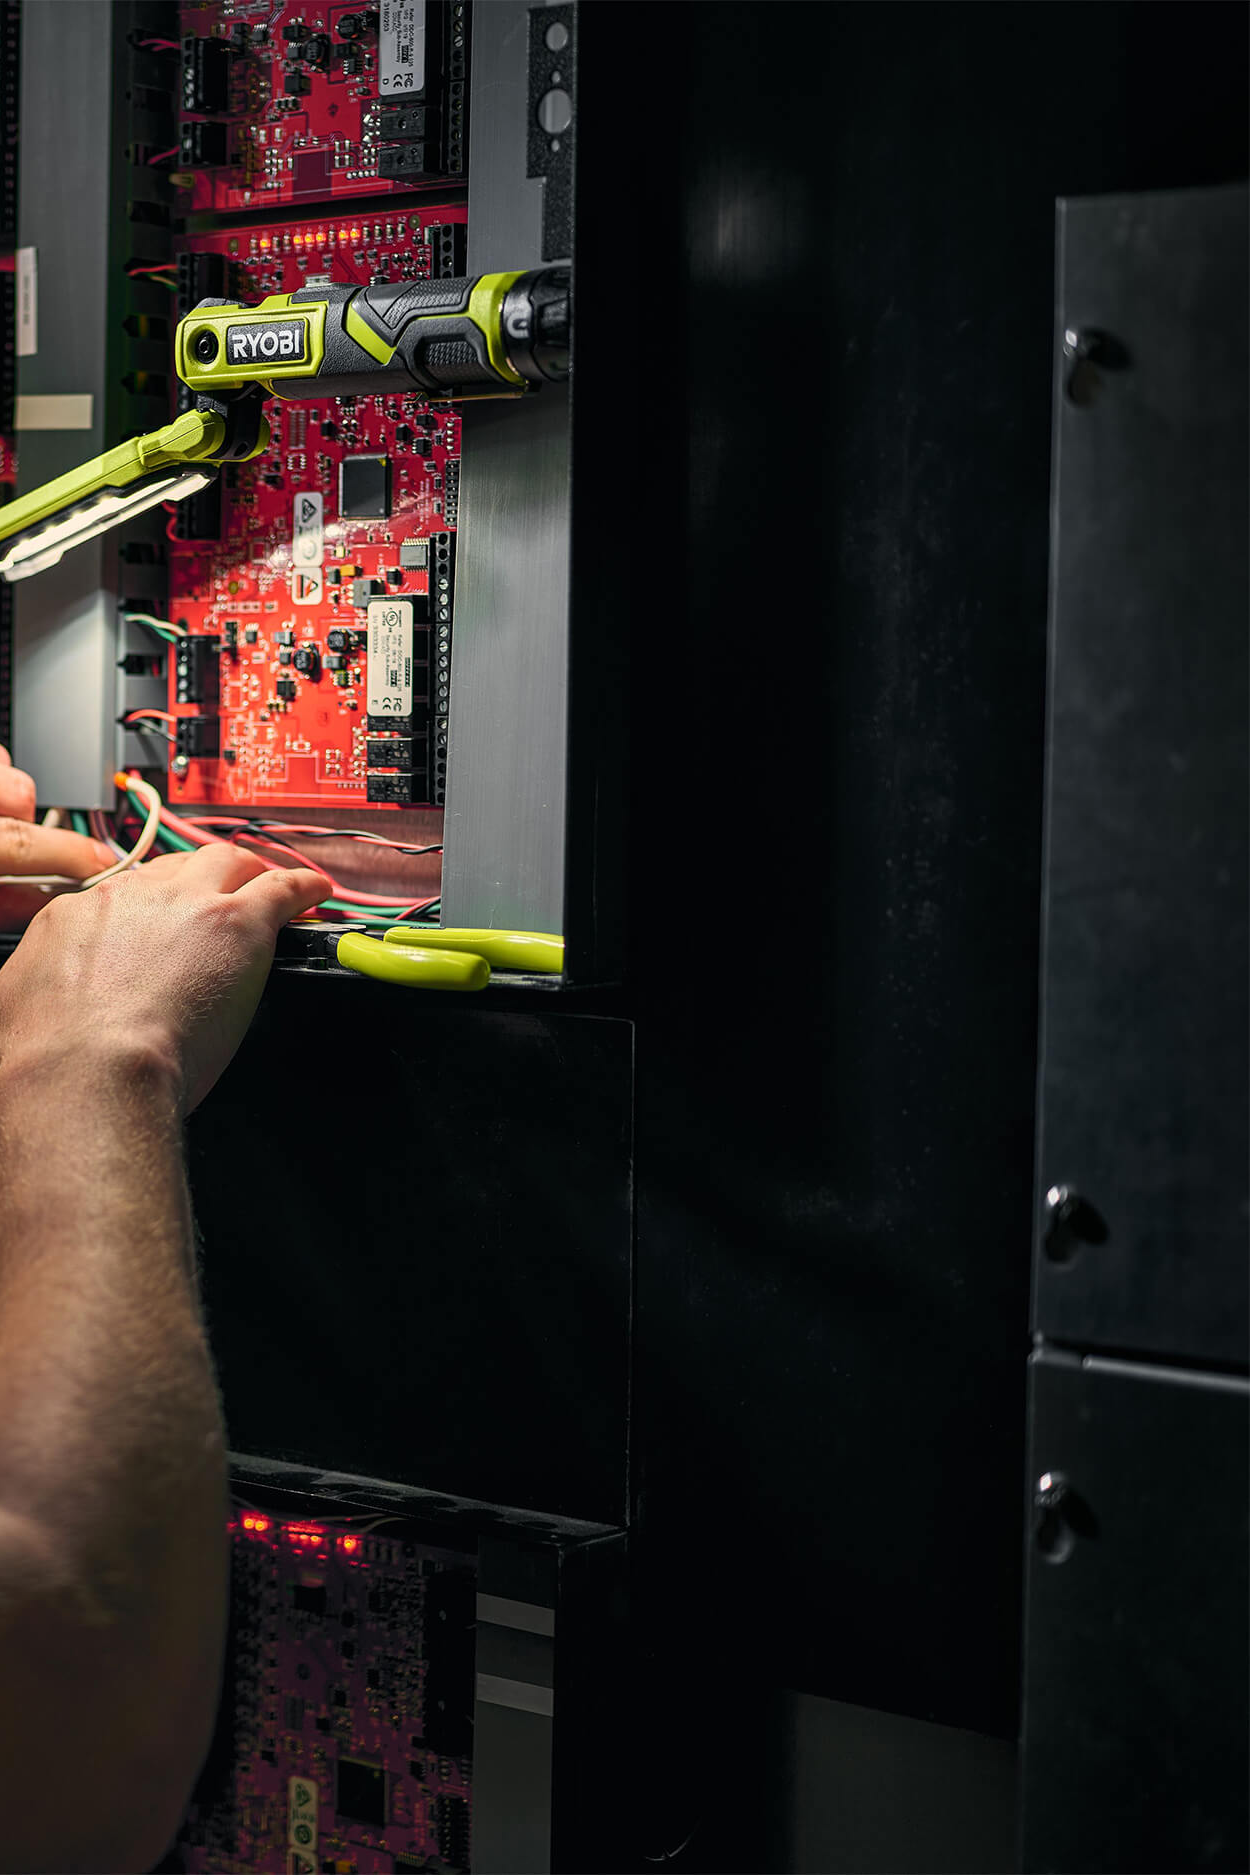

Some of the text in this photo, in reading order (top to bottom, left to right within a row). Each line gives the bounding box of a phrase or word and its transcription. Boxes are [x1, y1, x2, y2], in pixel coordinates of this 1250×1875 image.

[393, 74, 403, 88] CE
[232, 330, 299, 358] RYOBI
[382, 697, 392, 710] CE
